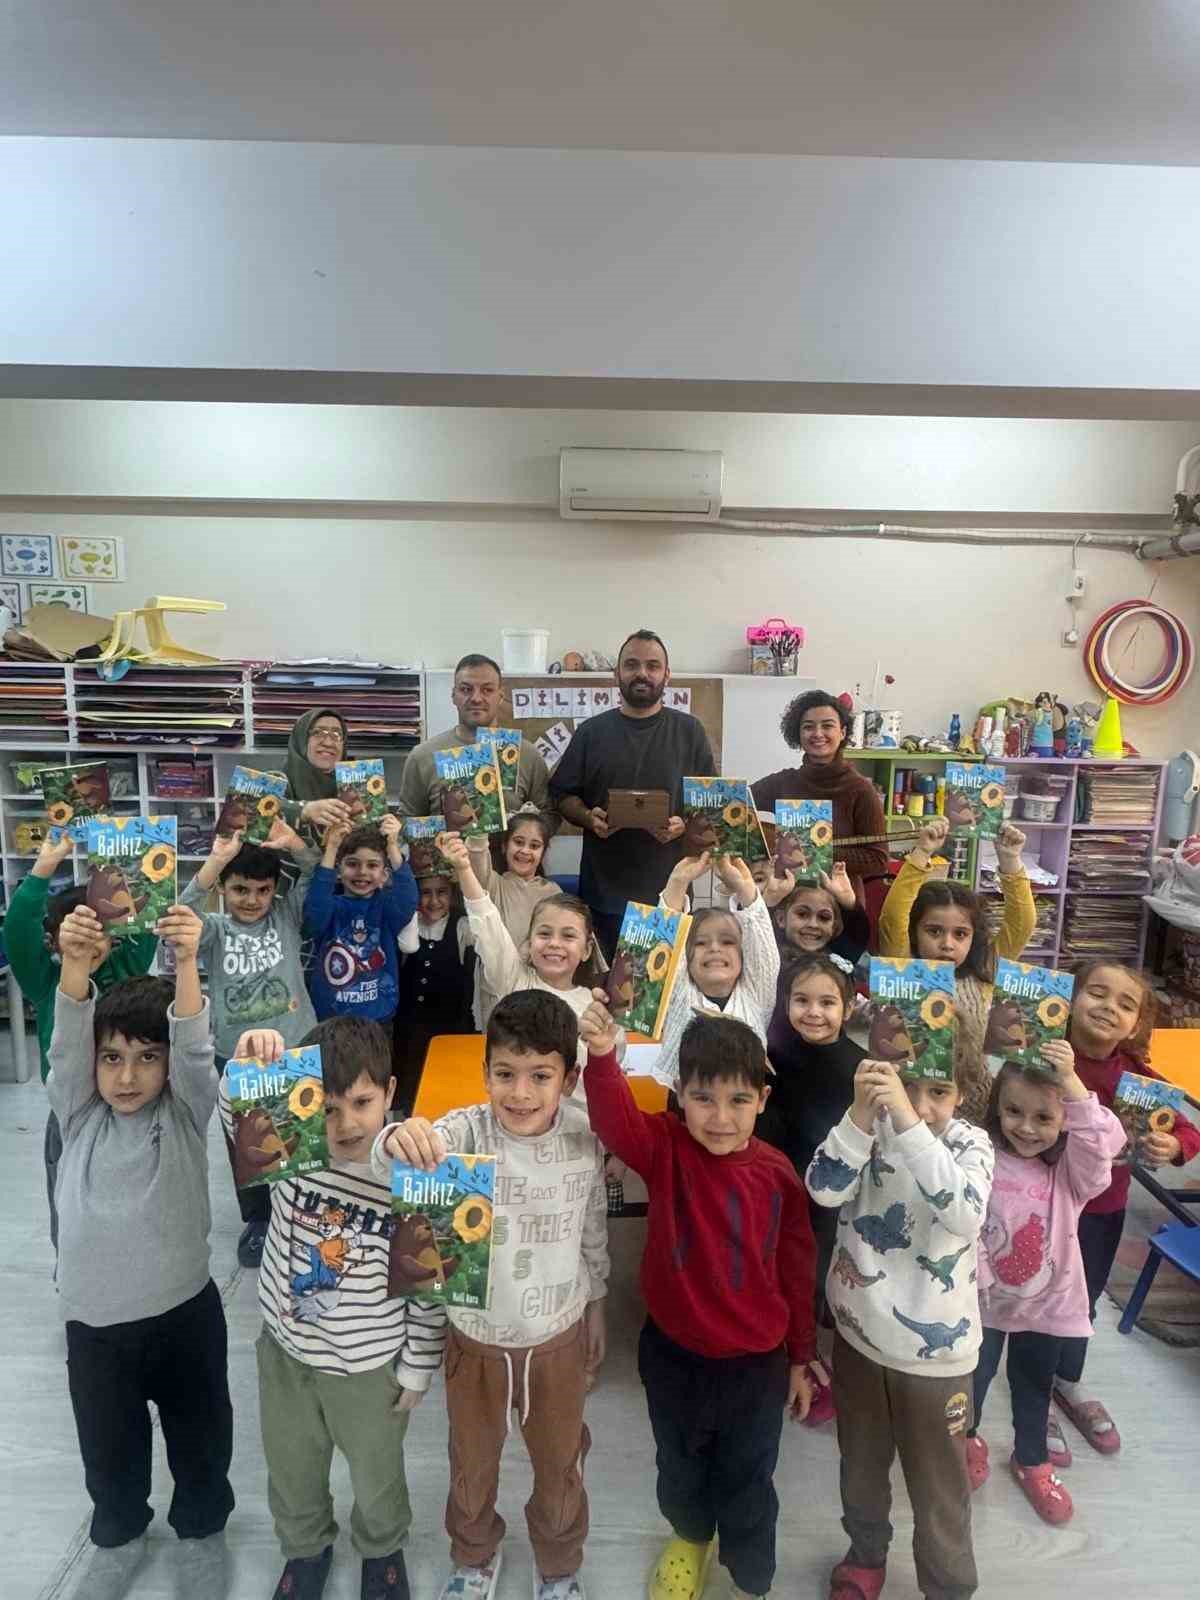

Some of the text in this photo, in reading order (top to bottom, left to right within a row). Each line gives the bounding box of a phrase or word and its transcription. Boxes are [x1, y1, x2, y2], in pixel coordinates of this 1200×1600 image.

[443, 760, 475, 780] Balkız
[951, 771, 983, 789] Balkız
[690, 791, 723, 808] Balkız
[781, 811, 812, 828] Balkız
[97, 834, 143, 857] Balkız
[624, 920, 655, 952] Balkız
[879, 975, 922, 1001] Balkız
[1002, 973, 1042, 1000] Balkız
[240, 1073, 289, 1101] Balkız
[1122, 1086, 1157, 1110] Balkız
[403, 1176, 455, 1207] Balkız
[517, 1211, 575, 1244] THE
